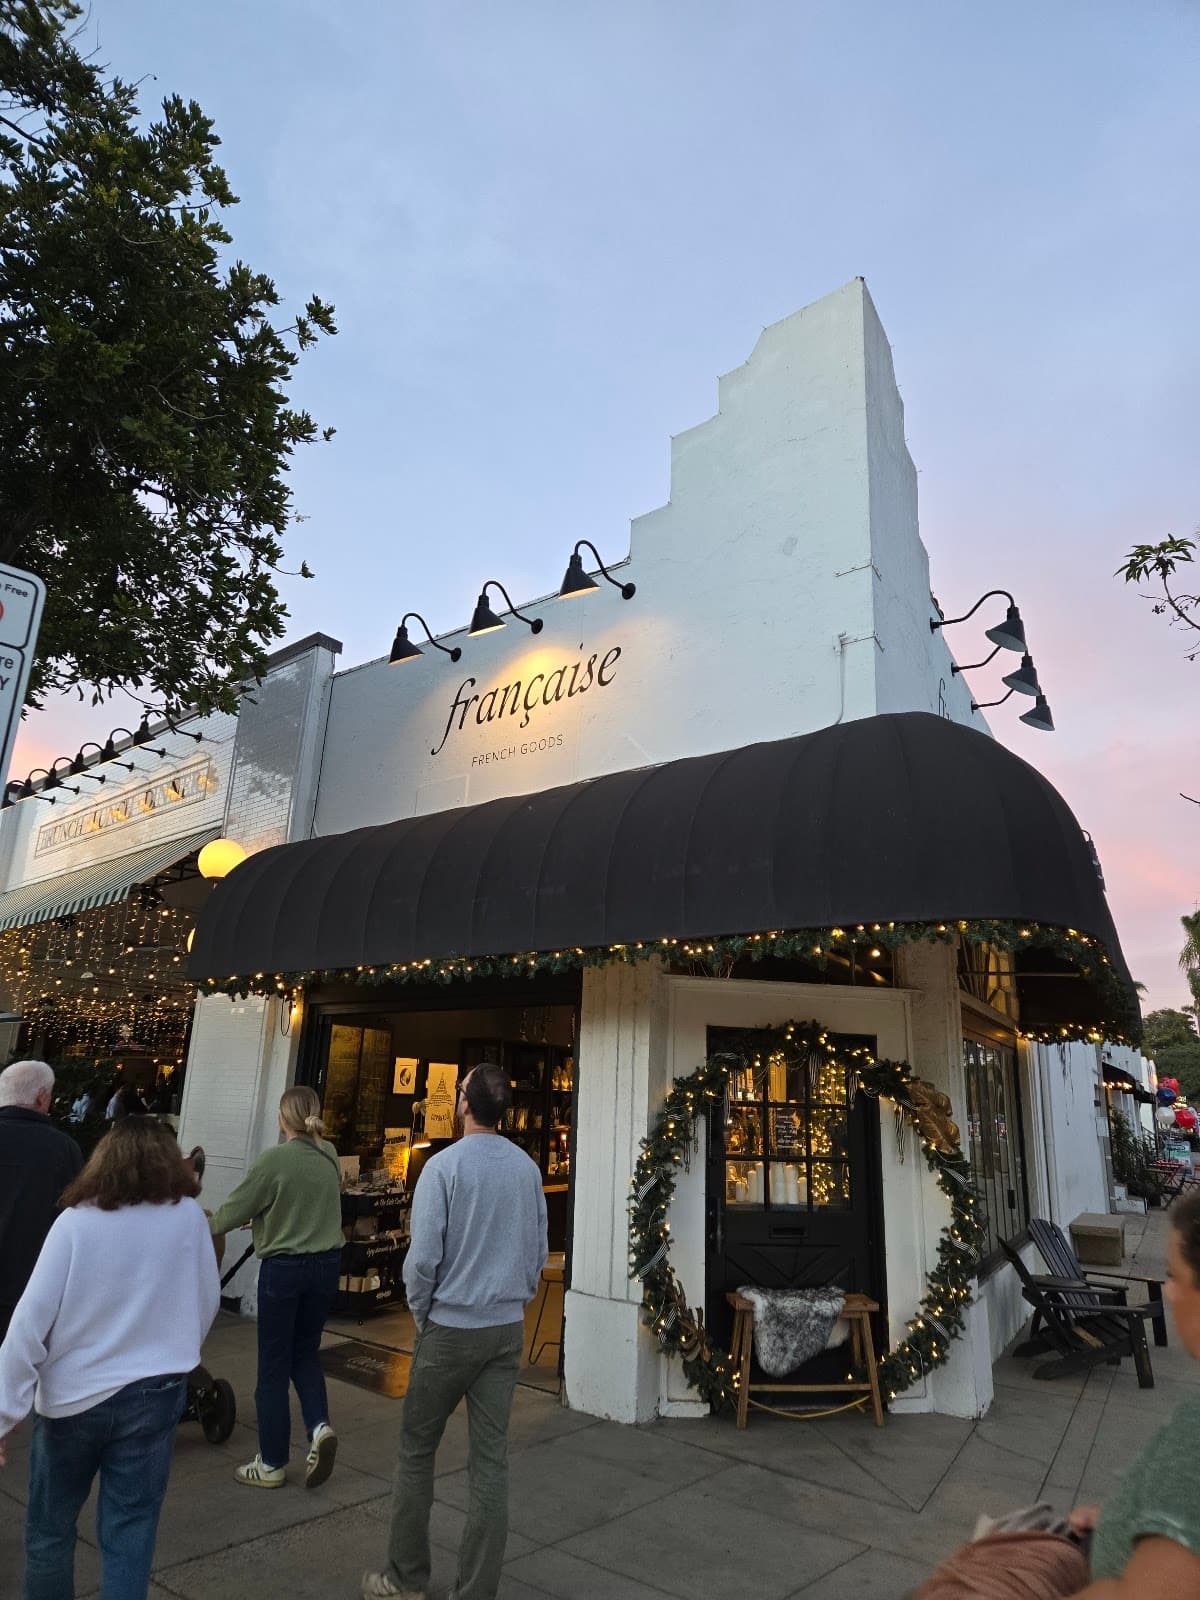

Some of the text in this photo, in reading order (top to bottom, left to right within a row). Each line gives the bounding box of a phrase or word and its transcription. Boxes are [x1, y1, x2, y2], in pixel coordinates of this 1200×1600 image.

[5, 583, 28, 598] Free
[431, 642, 622, 755] française
[471, 734, 564, 767] FRENCH GOODS
